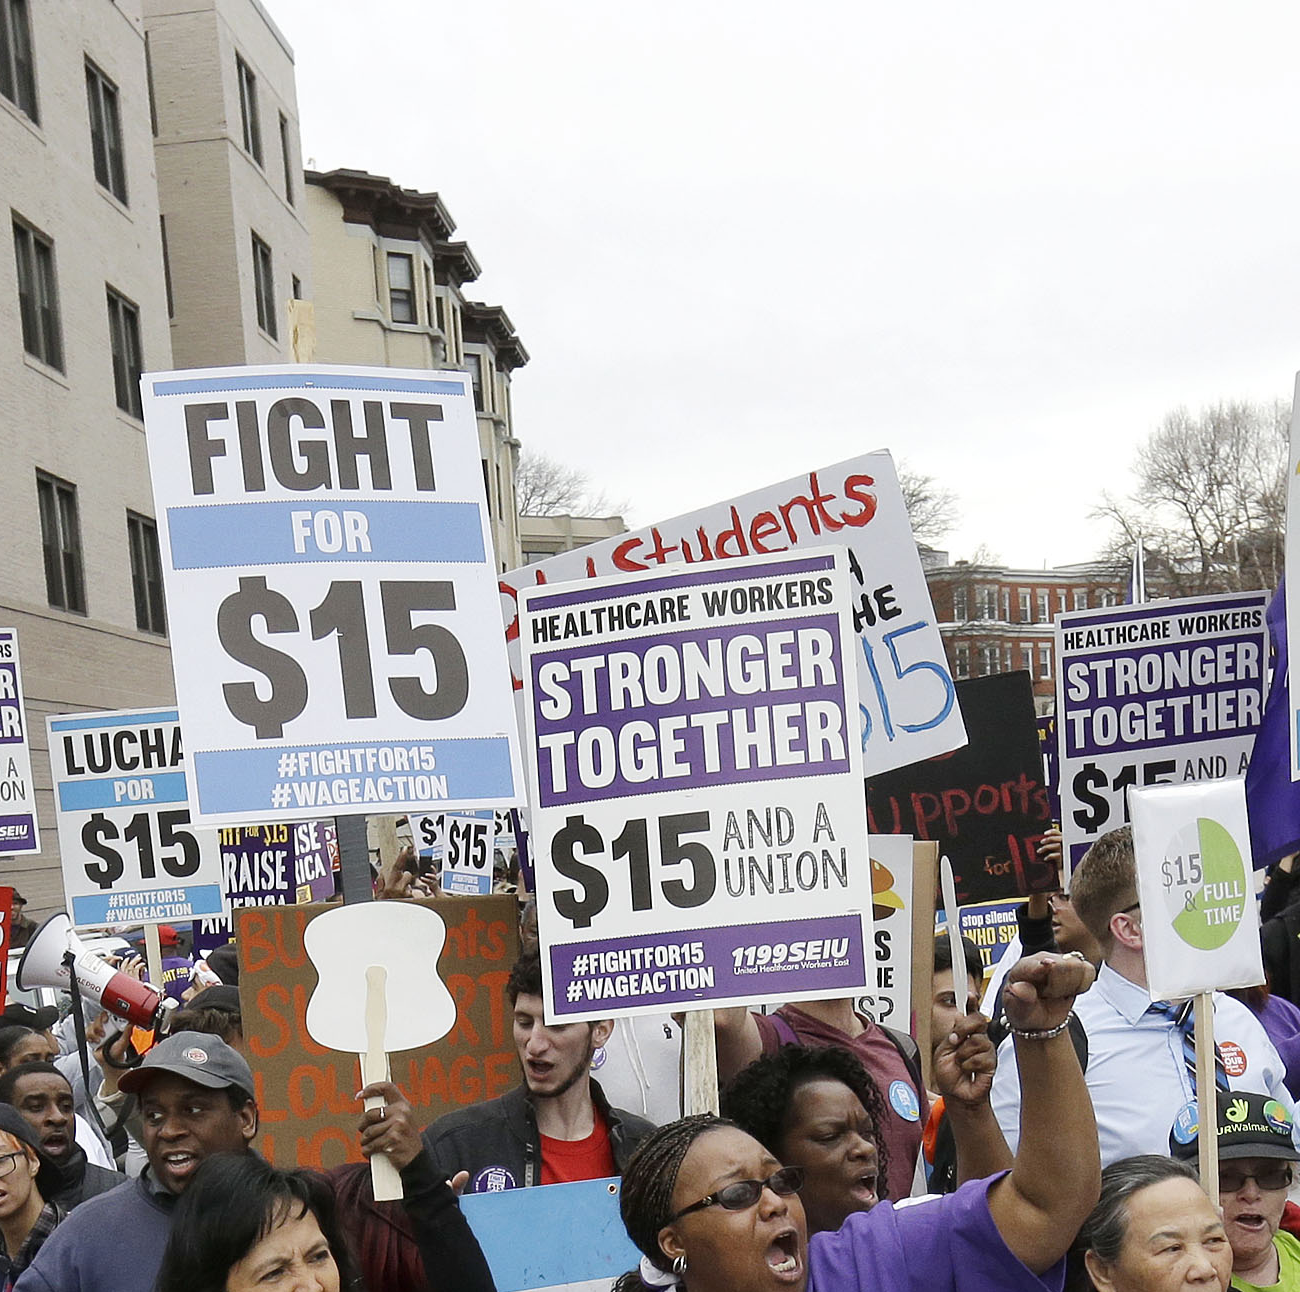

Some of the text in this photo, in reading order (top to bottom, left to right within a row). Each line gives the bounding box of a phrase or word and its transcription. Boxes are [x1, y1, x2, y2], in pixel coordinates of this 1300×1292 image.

[184, 397, 444, 495] FIGHT
[291, 508, 373, 554] FOR
[612, 472, 878, 571] Students
[531, 594, 692, 644] HEALTHCARE
[702, 577, 834, 621] WORKERS
[1063, 609, 1262, 651] HEALTHCARE WORKERS
[217, 575, 469, 740] $15
[537, 627, 839, 722] STRONGER
[1066, 642, 1259, 703] STRONGER
[1067, 688, 1262, 751] TOGETHER
[63, 729, 185, 776] LUCHA
[277, 745, 436, 779] #FIGHTFOR15
[538, 698, 847, 795] TOGETHER
[6, 760, 19, 778] A
[1183, 754, 1228, 782] AND
[114, 778, 155, 802] POR
[271, 774, 449, 808] #WAGEACTION
[420, 814, 444, 846] $1
[448, 820, 488, 870] $15
[722, 802, 836, 853] AND A
[81, 809, 202, 889] $15
[550, 809, 717, 929] $15
[222, 850, 289, 894] RAISE
[723, 847, 849, 898] UNION
[1161, 851, 1203, 890] $15
[1203, 880, 1243, 903] FULL
[105, 902, 192, 923] #WAGEACTION
[108, 889, 186, 909] #FIGHTFOR15
[961, 912, 984, 928] stop
[1204, 904, 1242, 926] TIME
[571, 942, 705, 976] #FIGHTFOR15
[731, 937, 849, 965] 1199SEIU
[733, 958, 850, 976] United Healthcare Workers East
[566, 967, 715, 1002] #WAGEACTION
